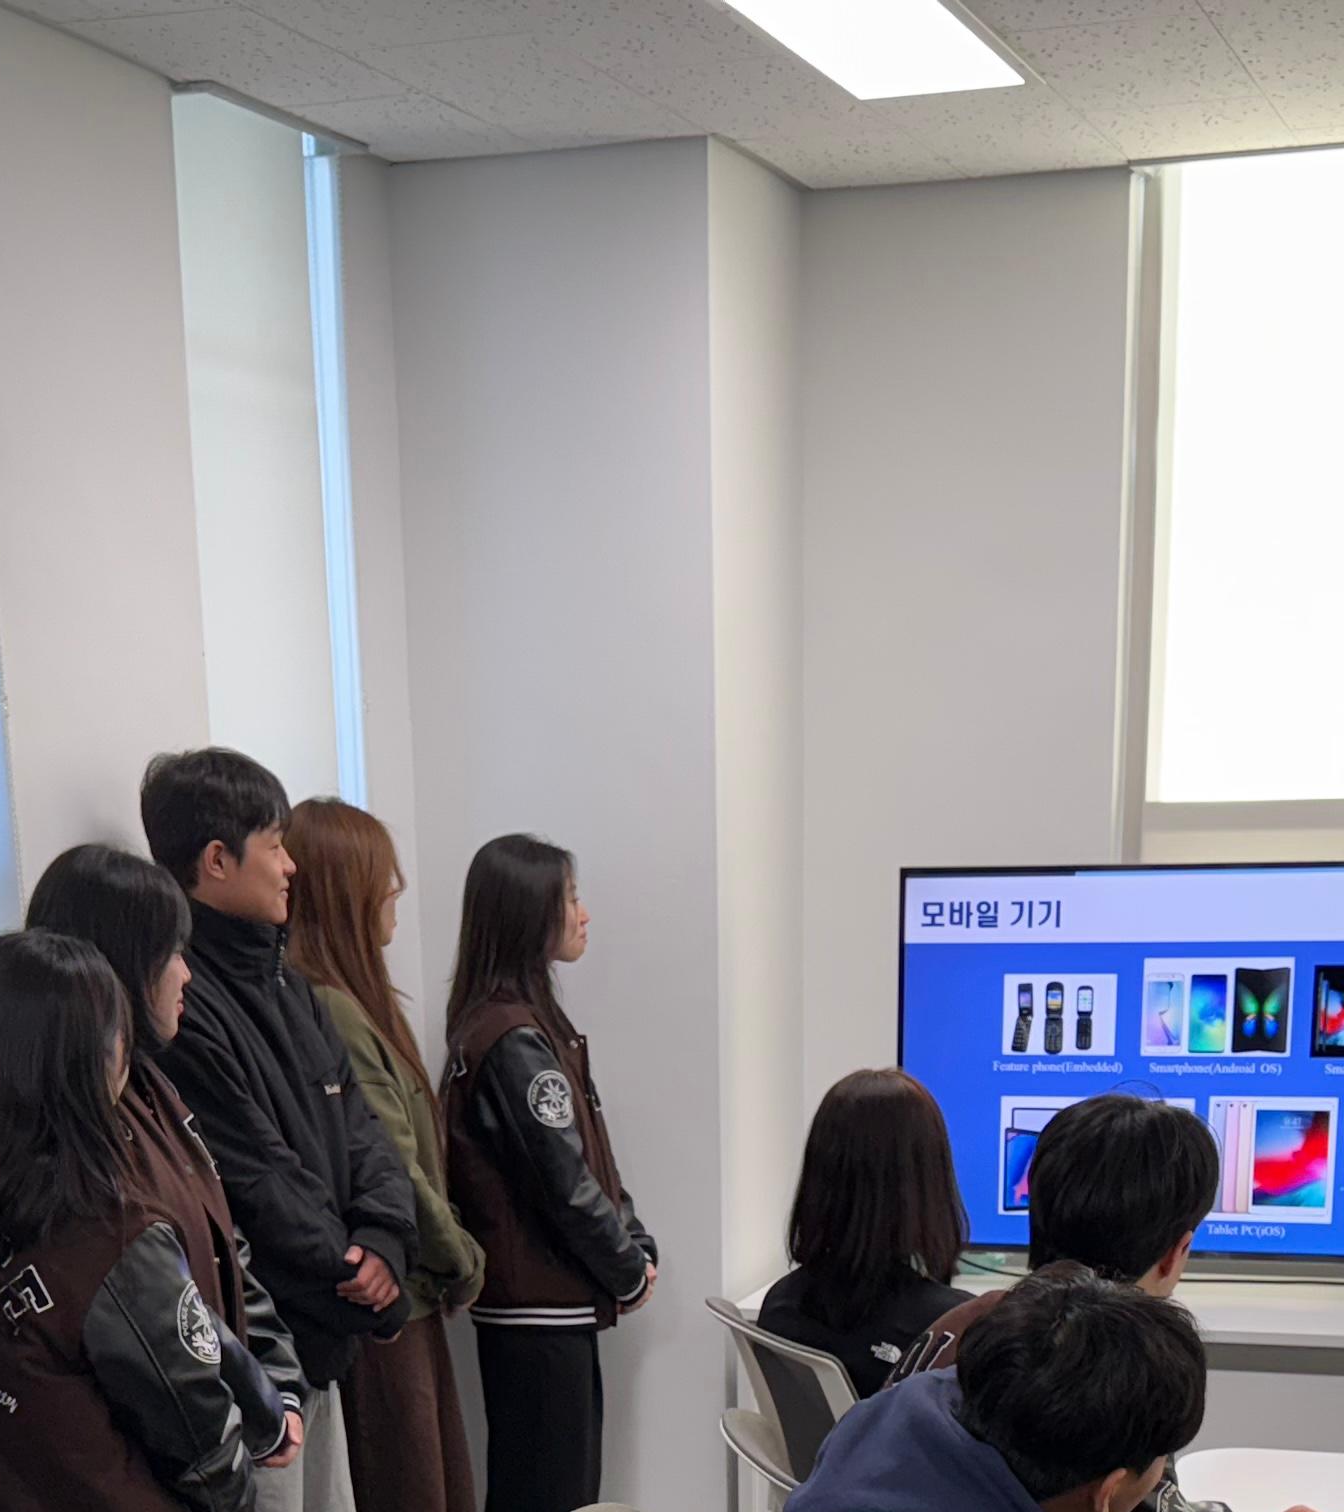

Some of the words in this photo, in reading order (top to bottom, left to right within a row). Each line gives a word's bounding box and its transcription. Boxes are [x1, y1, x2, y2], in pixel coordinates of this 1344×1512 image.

[921, 900, 999, 929] 모바일
[1010, 900, 1061, 929] 기기
[992, 1060, 1030, 1072] Feature
[1031, 1061, 1124, 1075] phone(Embedded)
[1149, 1061, 1256, 1076] Smartphone(Android
[1260, 1062, 1283, 1076] OS)
[1206, 1223, 1238, 1236] Tablet
[1240, 1224, 1286, 1240] PC(iOS)
